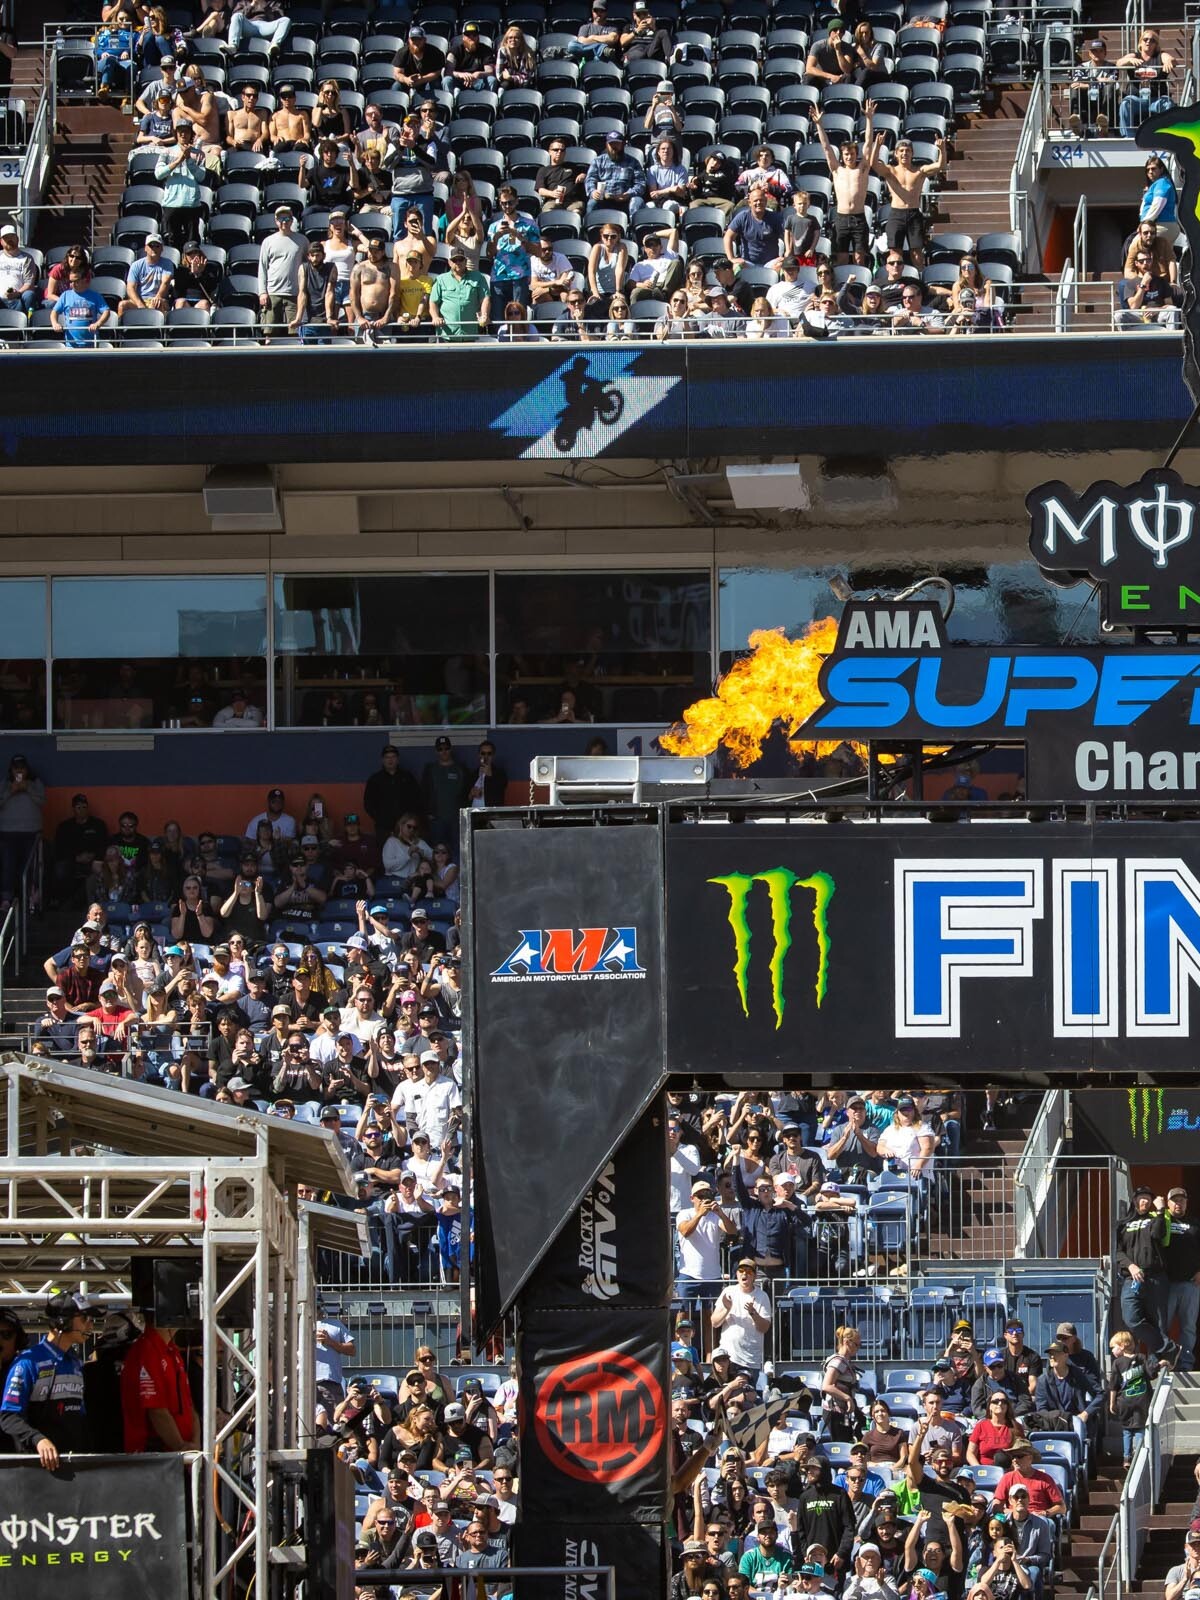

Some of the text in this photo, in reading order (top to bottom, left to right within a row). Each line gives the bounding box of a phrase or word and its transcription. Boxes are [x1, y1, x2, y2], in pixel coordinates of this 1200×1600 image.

[3, 163, 22, 178] 32
[1051, 145, 1083, 160] 324
[844, 610, 941, 649] AMA
[489, 927, 647, 975] AMA
[491, 972, 646, 983] AMERICAN MOTORCYCLIST ASSOCIATION
[579, 1206, 594, 1271] ROCKY
[561, 1390, 642, 1444] RM
[0, 1513, 162, 1549] ONSTER
[0, 1550, 131, 1567] ENERGY
[565, 1538, 578, 1600] UNTAIN
